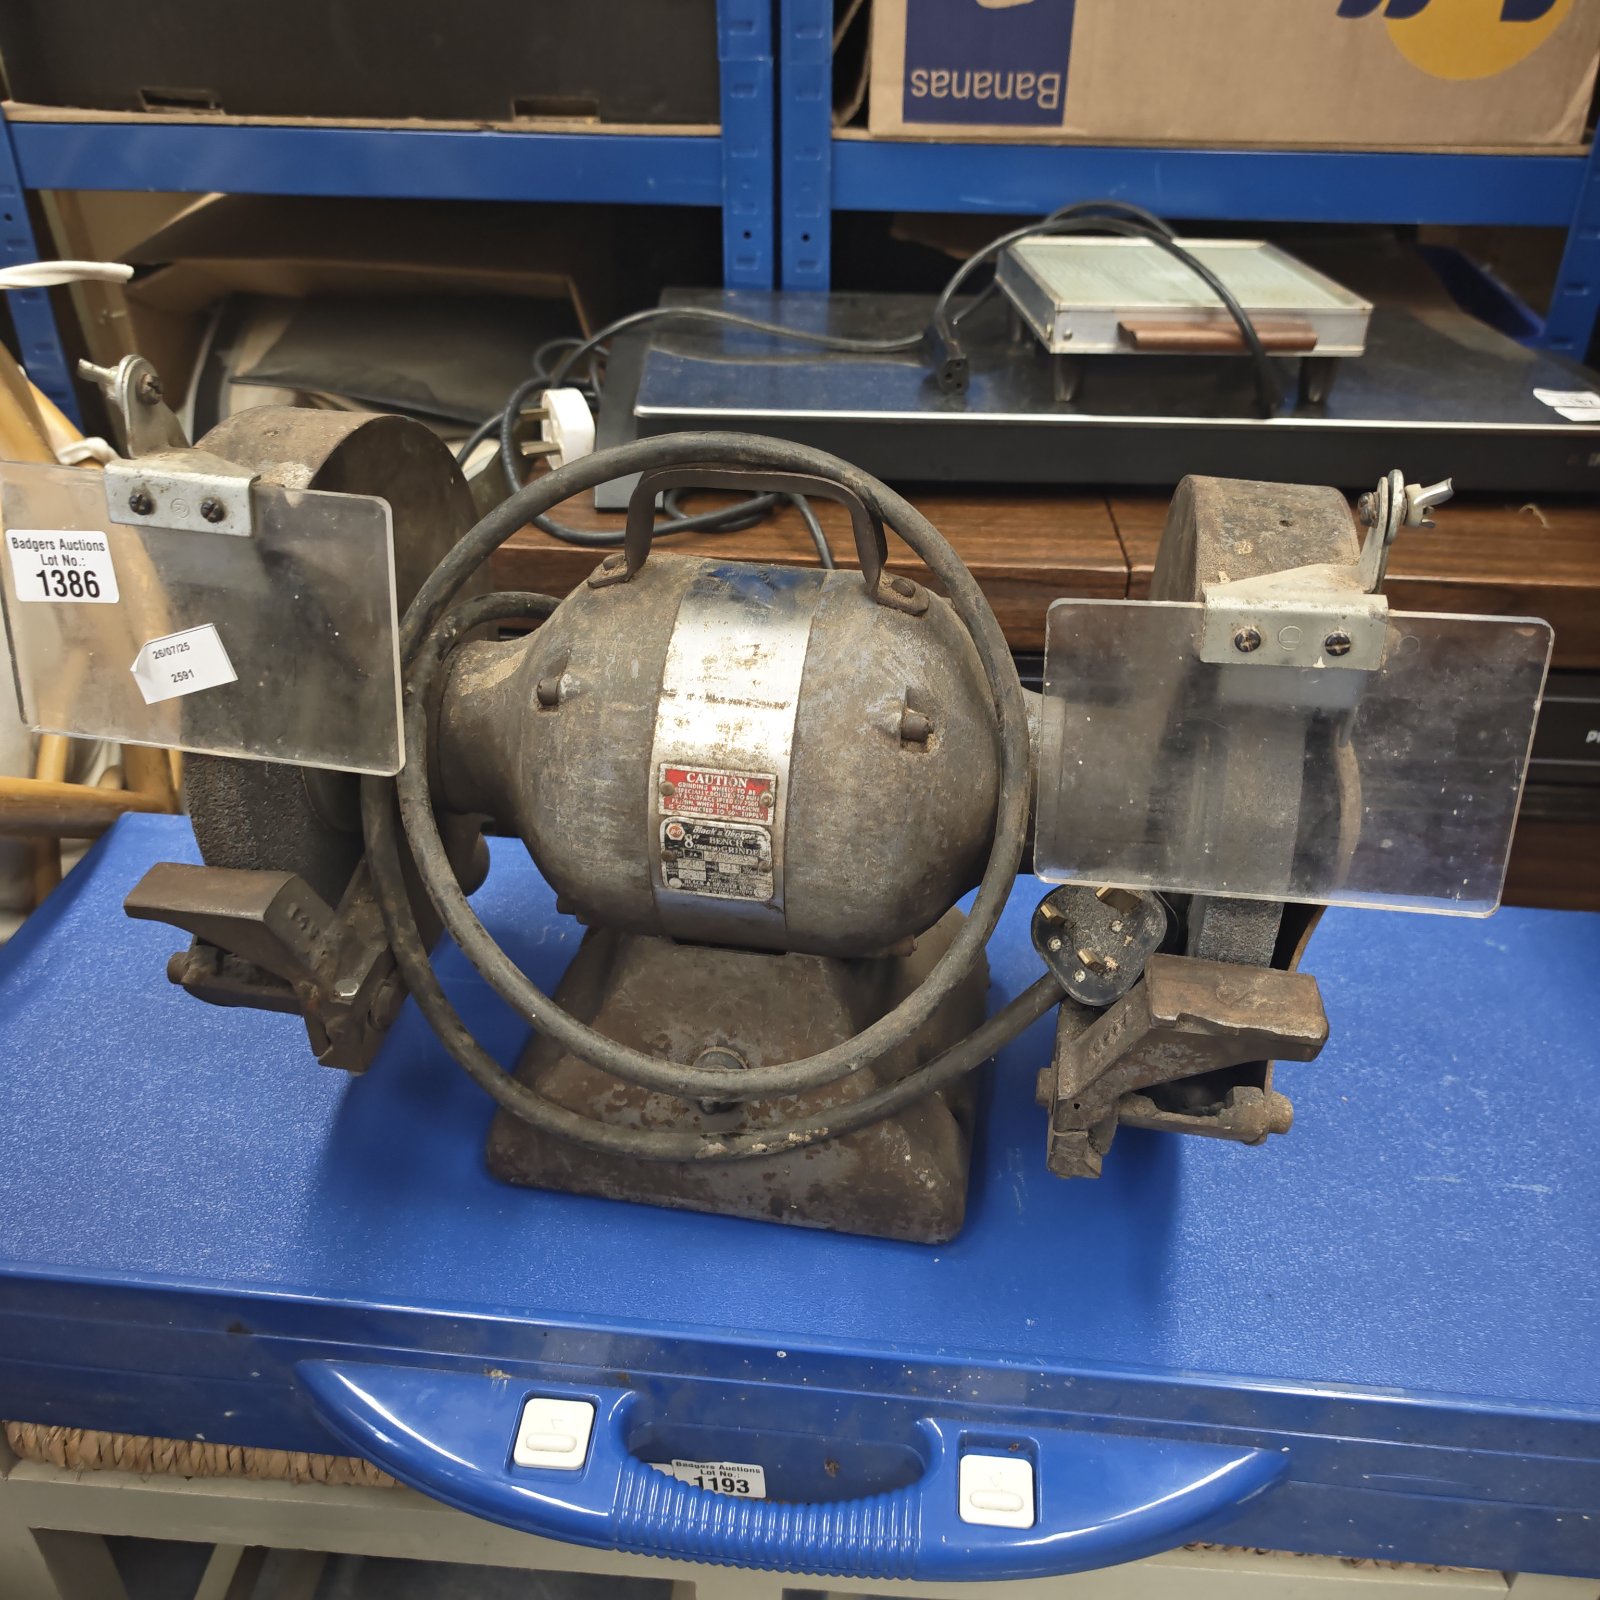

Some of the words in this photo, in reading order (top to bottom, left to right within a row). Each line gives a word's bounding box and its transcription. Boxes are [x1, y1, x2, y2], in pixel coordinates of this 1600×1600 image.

[911, 70, 1060, 109] Bananas
[11, 537, 55, 552] Badgers
[59, 538, 105, 551] Auctions
[40, 554, 59, 566] Lot
[61, 554, 86, 567] No.:
[36, 569, 100, 598] 1386
[152, 641, 191, 660] 26/07/25
[171, 669, 195, 683] 2591
[677, 781, 707, 789] GRINDING
[686, 772, 747, 788] CAUTION
[676, 804, 713, 813] CONNECTED
[692, 825, 714, 835] Black
[724, 829, 755, 840] Decker
[709, 836, 743, 846] BENCH
[675, 1461, 715, 1470] Badgers
[719, 1464, 760, 1474] Auctions
[694, 1476, 750, 1494] 1193
